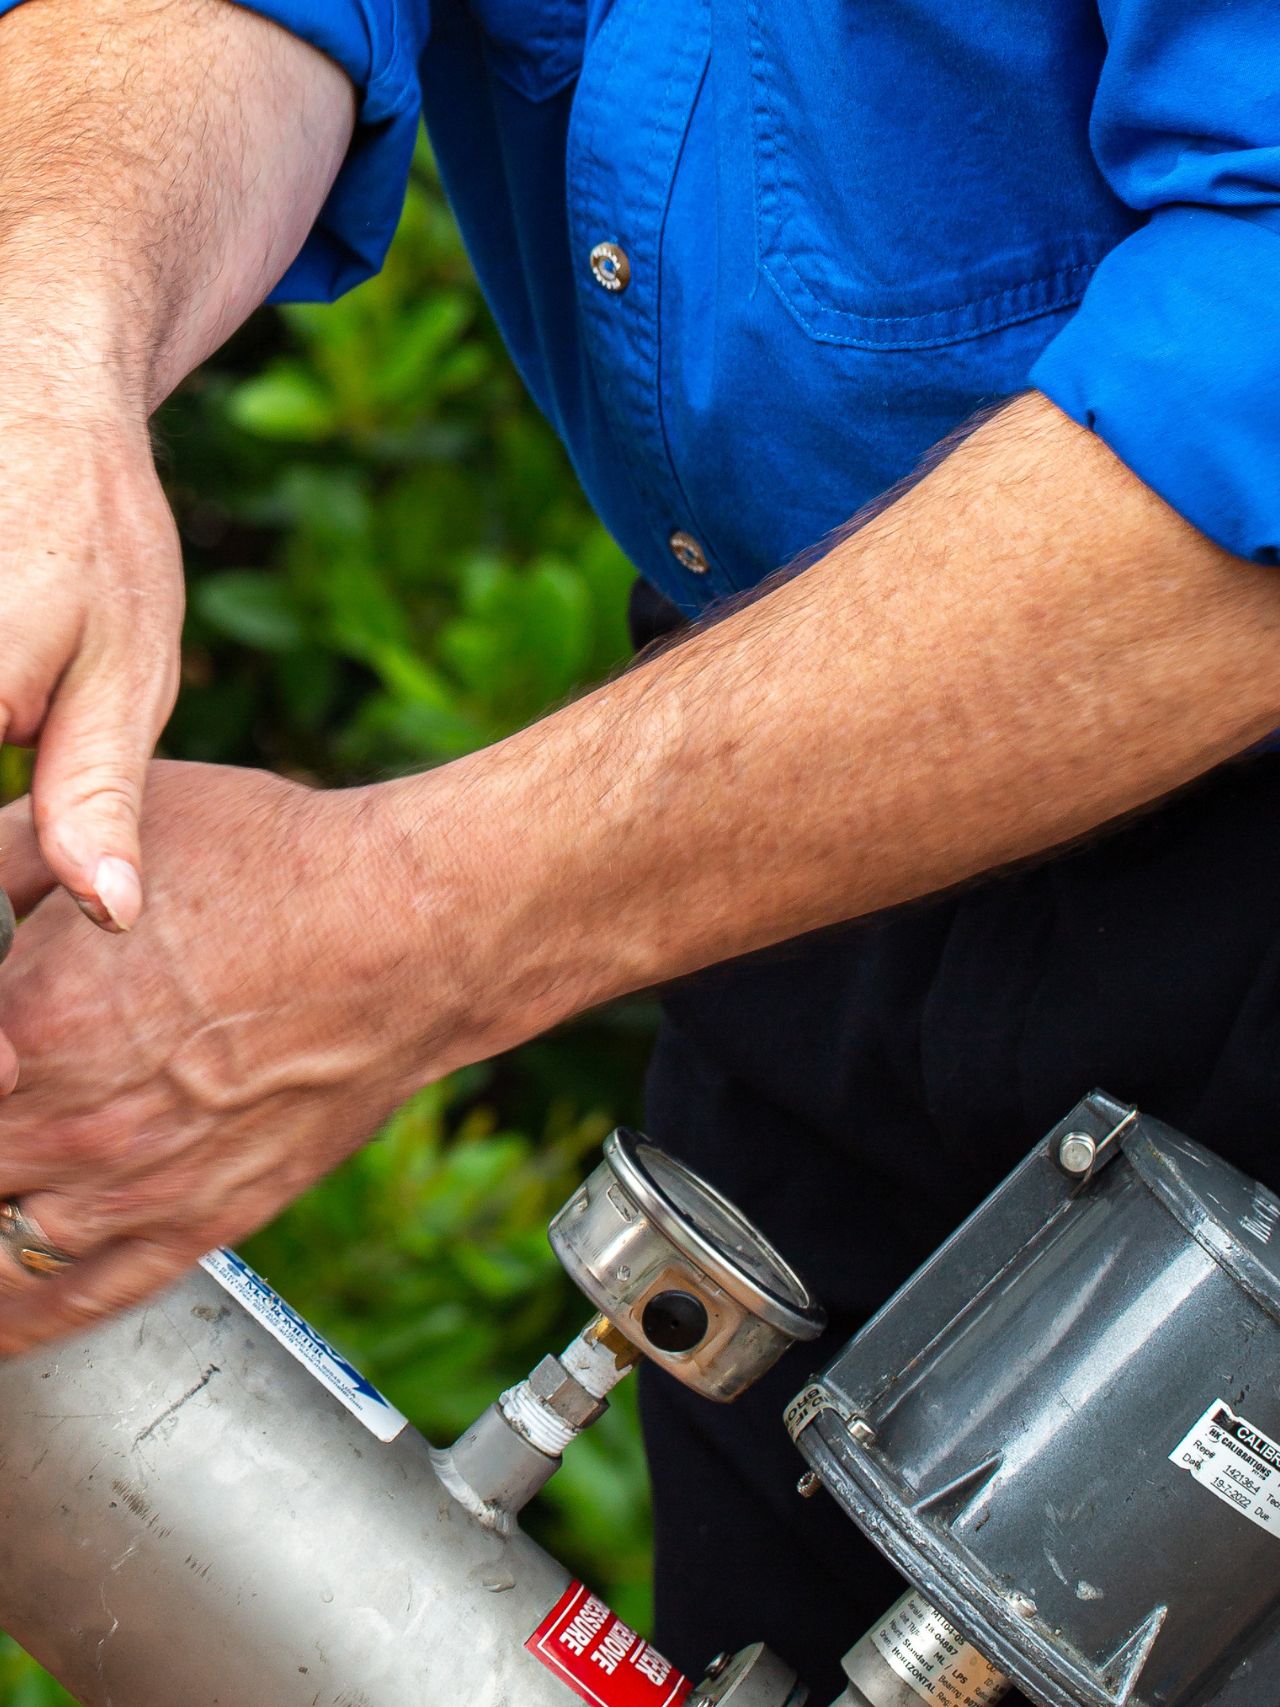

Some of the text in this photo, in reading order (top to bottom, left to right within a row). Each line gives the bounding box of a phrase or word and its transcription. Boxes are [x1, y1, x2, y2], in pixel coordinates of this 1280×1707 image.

[1221, 1437, 1272, 1478] CALIBRATIONS
[1237, 1427, 1280, 1467] CALIBR
[1213, 1476, 1252, 1507] 19-7-2022
[1225, 1464, 1261, 1493] 142136-4
[933, 1651, 946, 1666] ML
[952, 1669, 968, 1684] LPS
